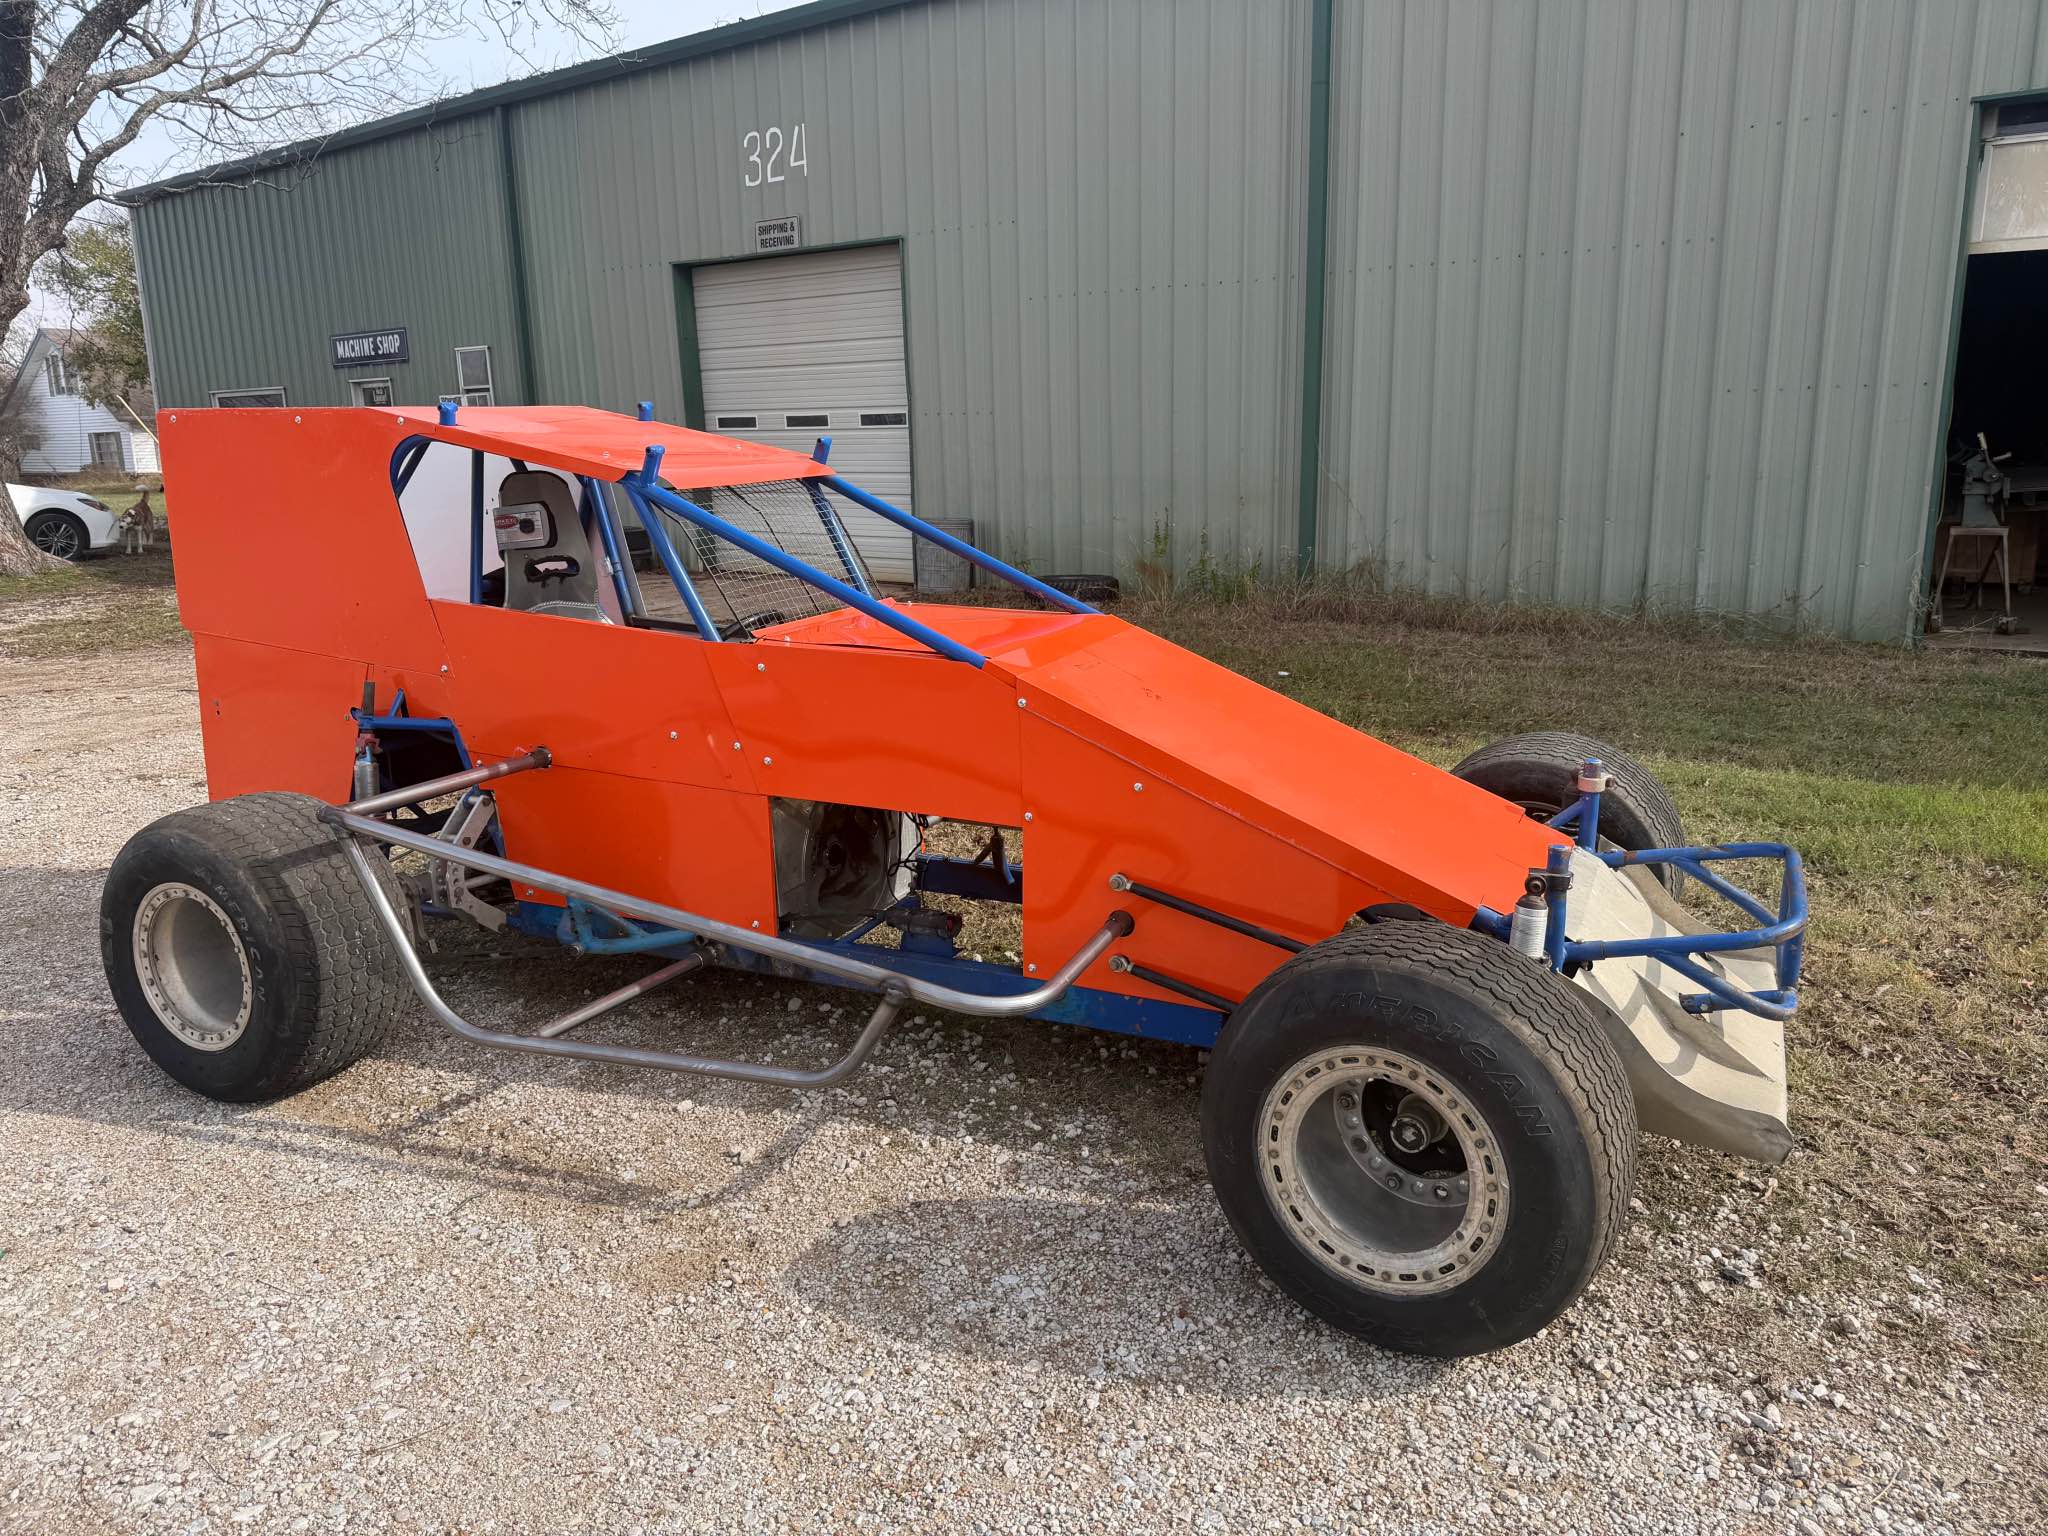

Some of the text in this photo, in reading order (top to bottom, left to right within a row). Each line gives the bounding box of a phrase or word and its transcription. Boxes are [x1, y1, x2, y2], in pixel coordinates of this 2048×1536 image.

[743, 122, 808, 187] 324
[757, 221, 795, 237] SHIPPING &
[760, 234, 795, 249] RECEIVING
[336, 334, 400, 359] MACHINE SHOP
